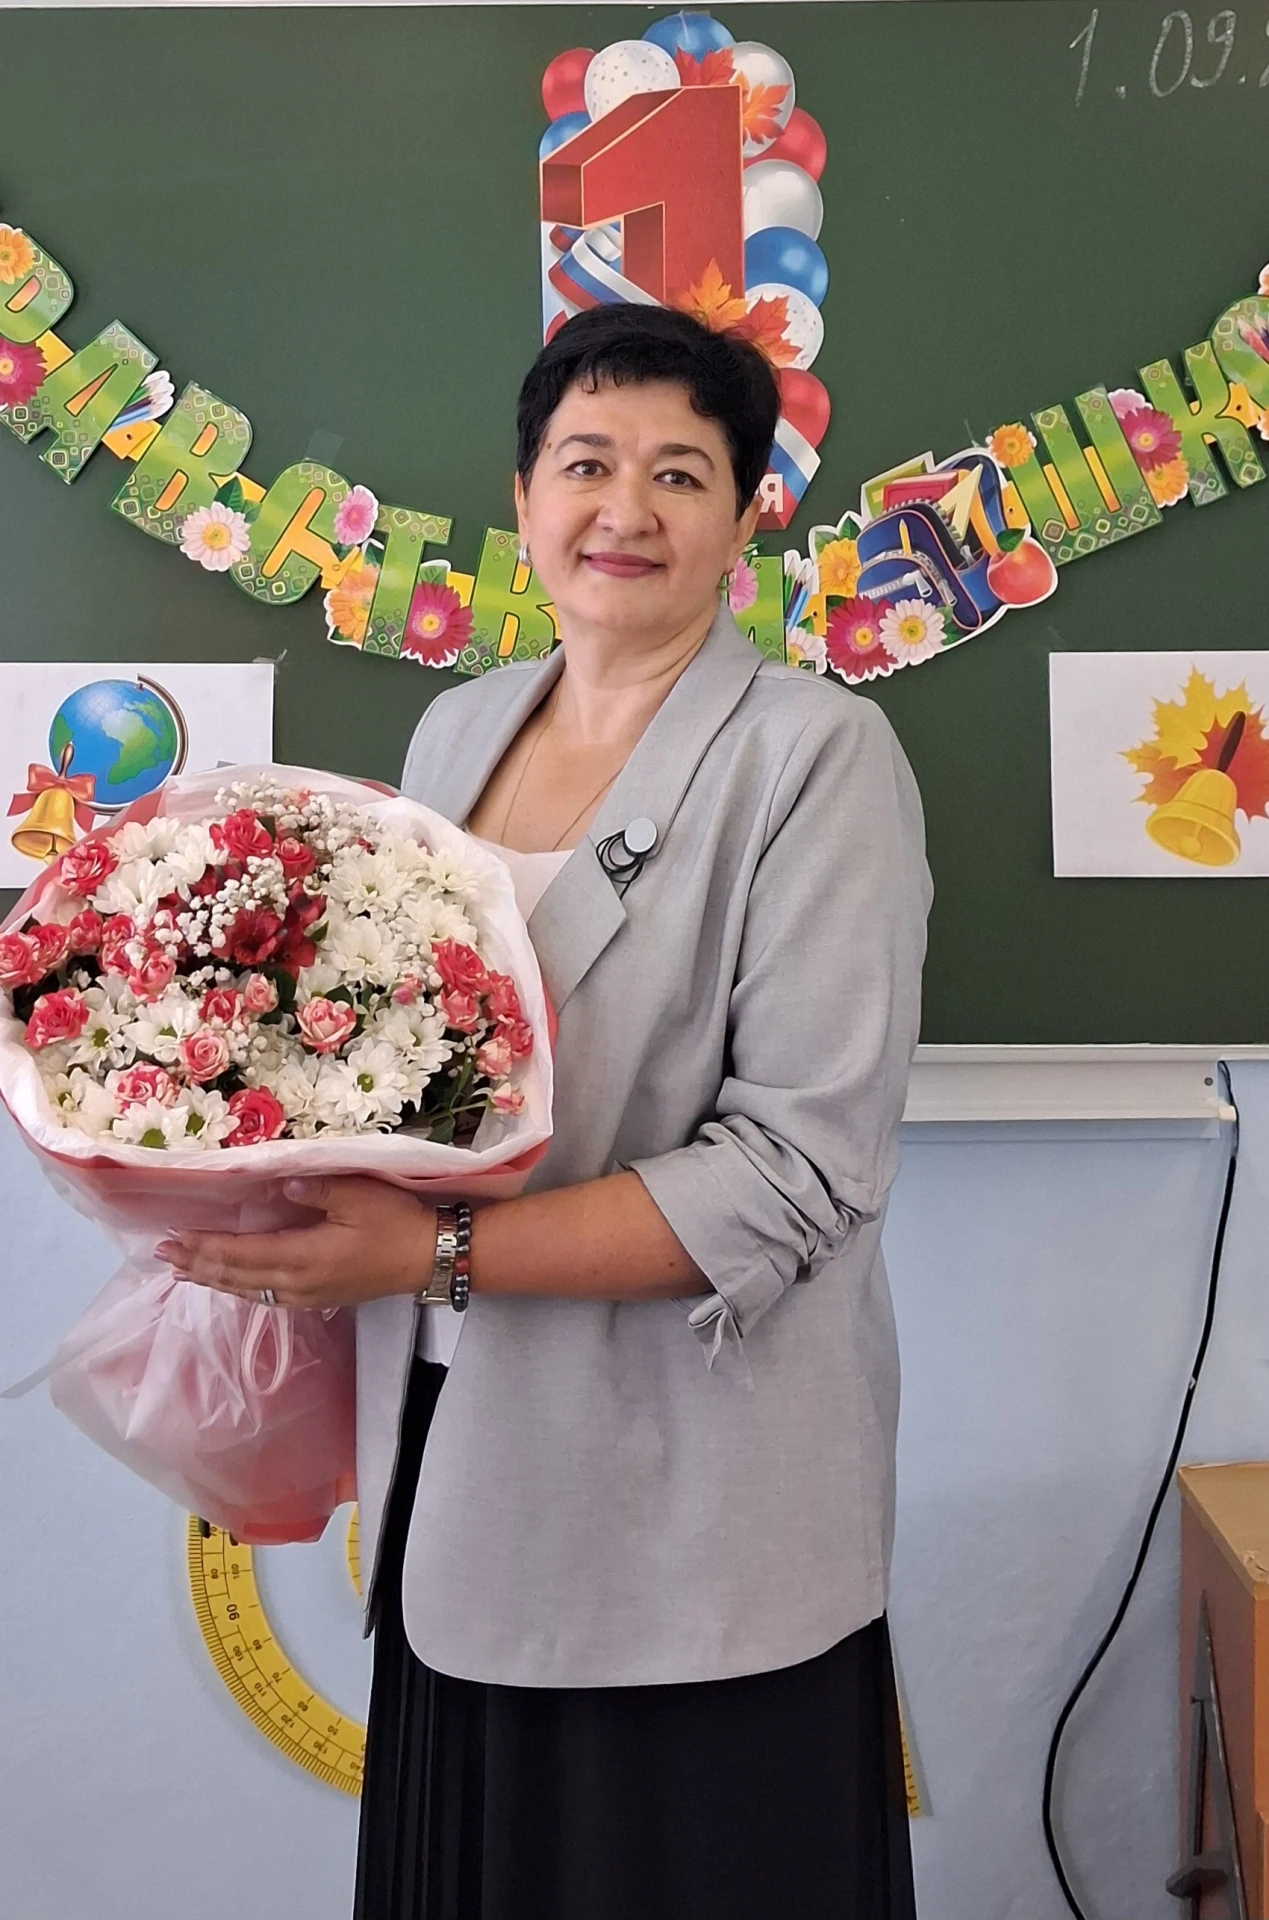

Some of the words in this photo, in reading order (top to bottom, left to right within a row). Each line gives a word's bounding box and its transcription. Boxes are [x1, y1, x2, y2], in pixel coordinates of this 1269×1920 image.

[1068, 8, 1269, 108] 1.09.
[226, 1603, 240, 1621] 90
[232, 1645, 245, 1662] 100
[271, 1671, 283, 1684] 70
[253, 1682, 268, 1697] 110
[280, 1713, 295, 1728] 120
